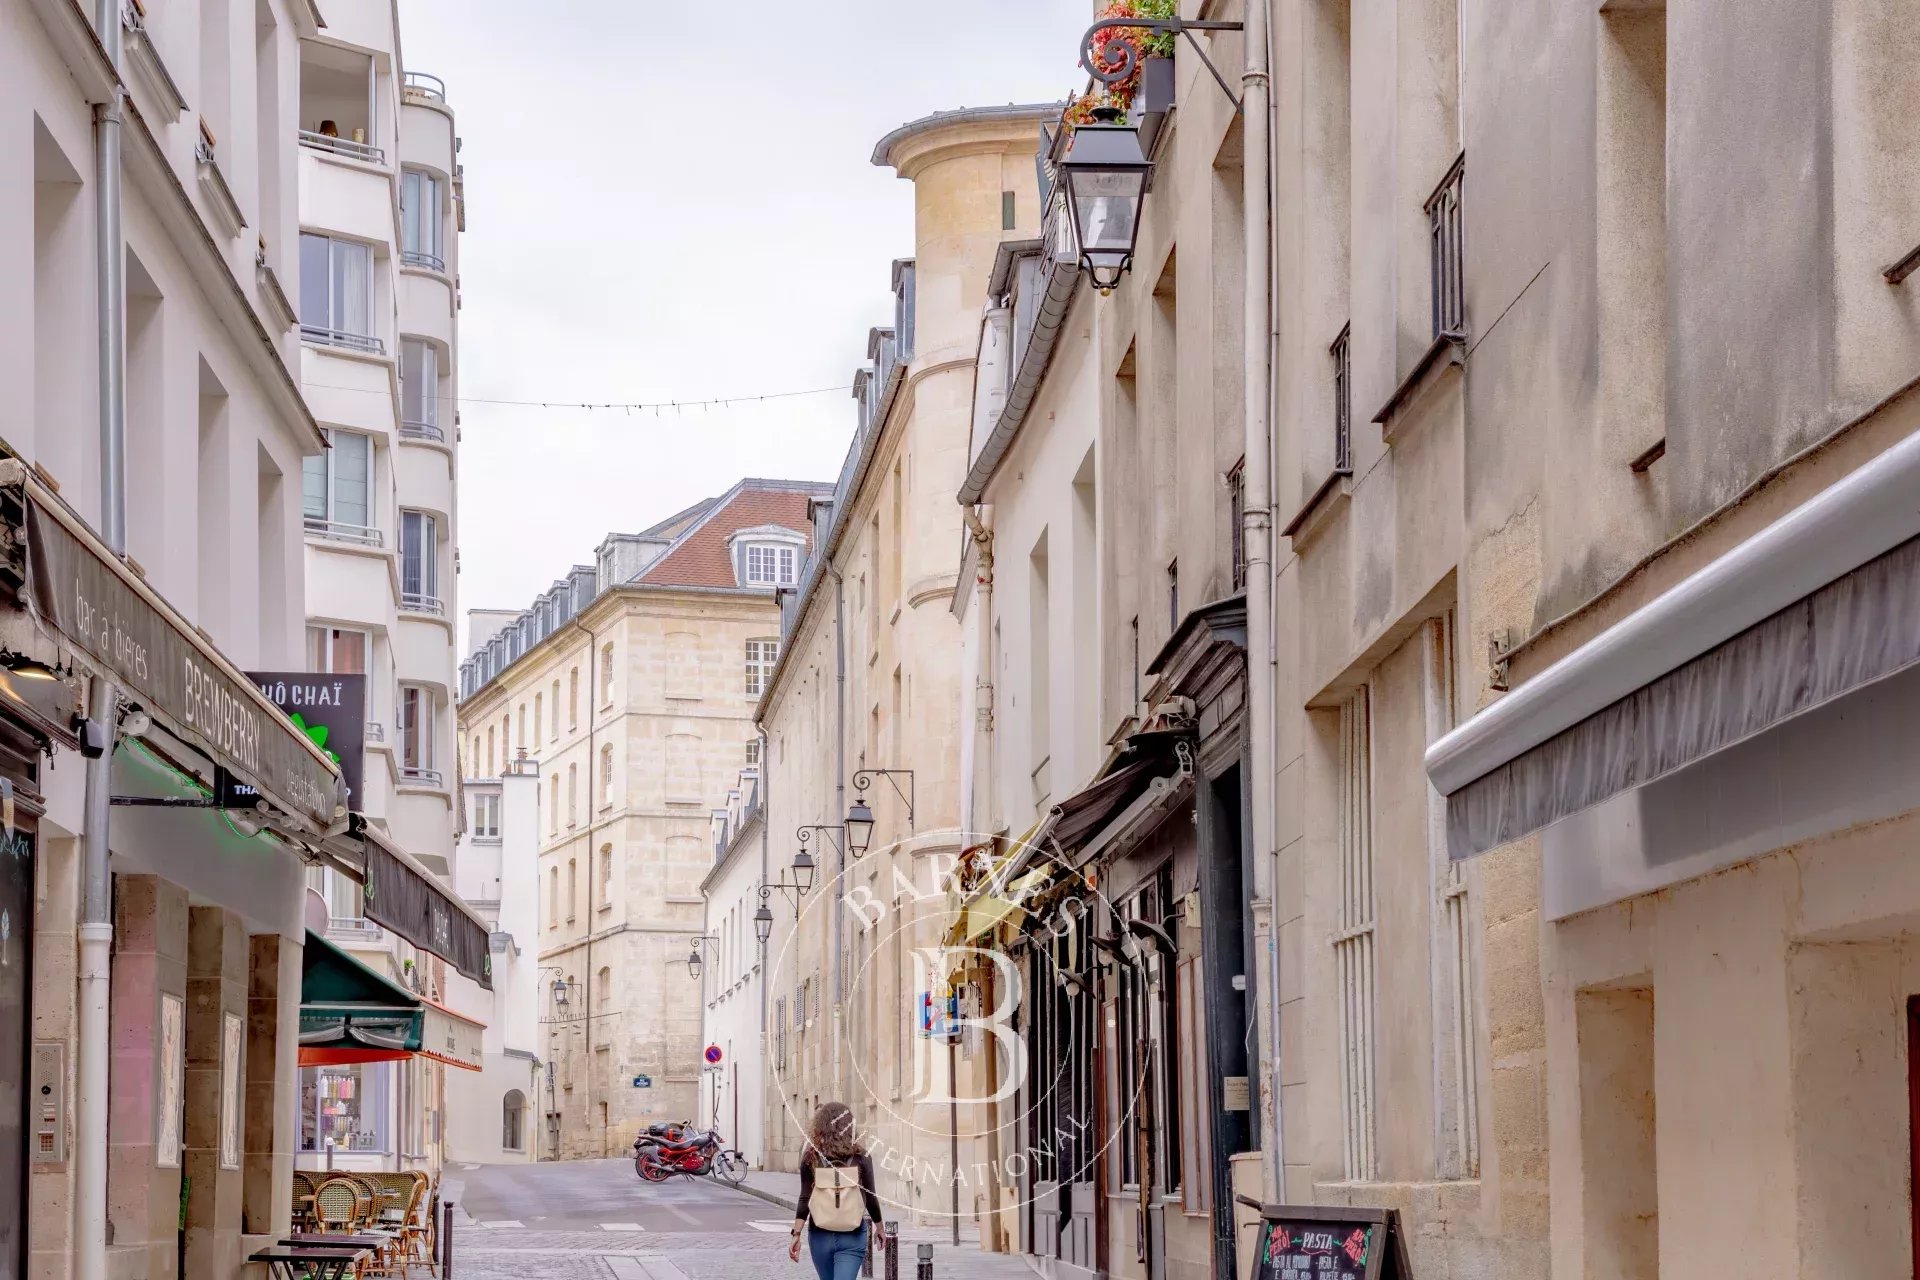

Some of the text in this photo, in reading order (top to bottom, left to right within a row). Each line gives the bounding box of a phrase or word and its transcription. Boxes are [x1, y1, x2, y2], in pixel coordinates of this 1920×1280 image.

[76, 577, 148, 680] bar à bières
[185, 656, 260, 773] BREWBERRY
[291, 682, 343, 706] CHAÏ
[1302, 1232, 1333, 1250] PASTA
